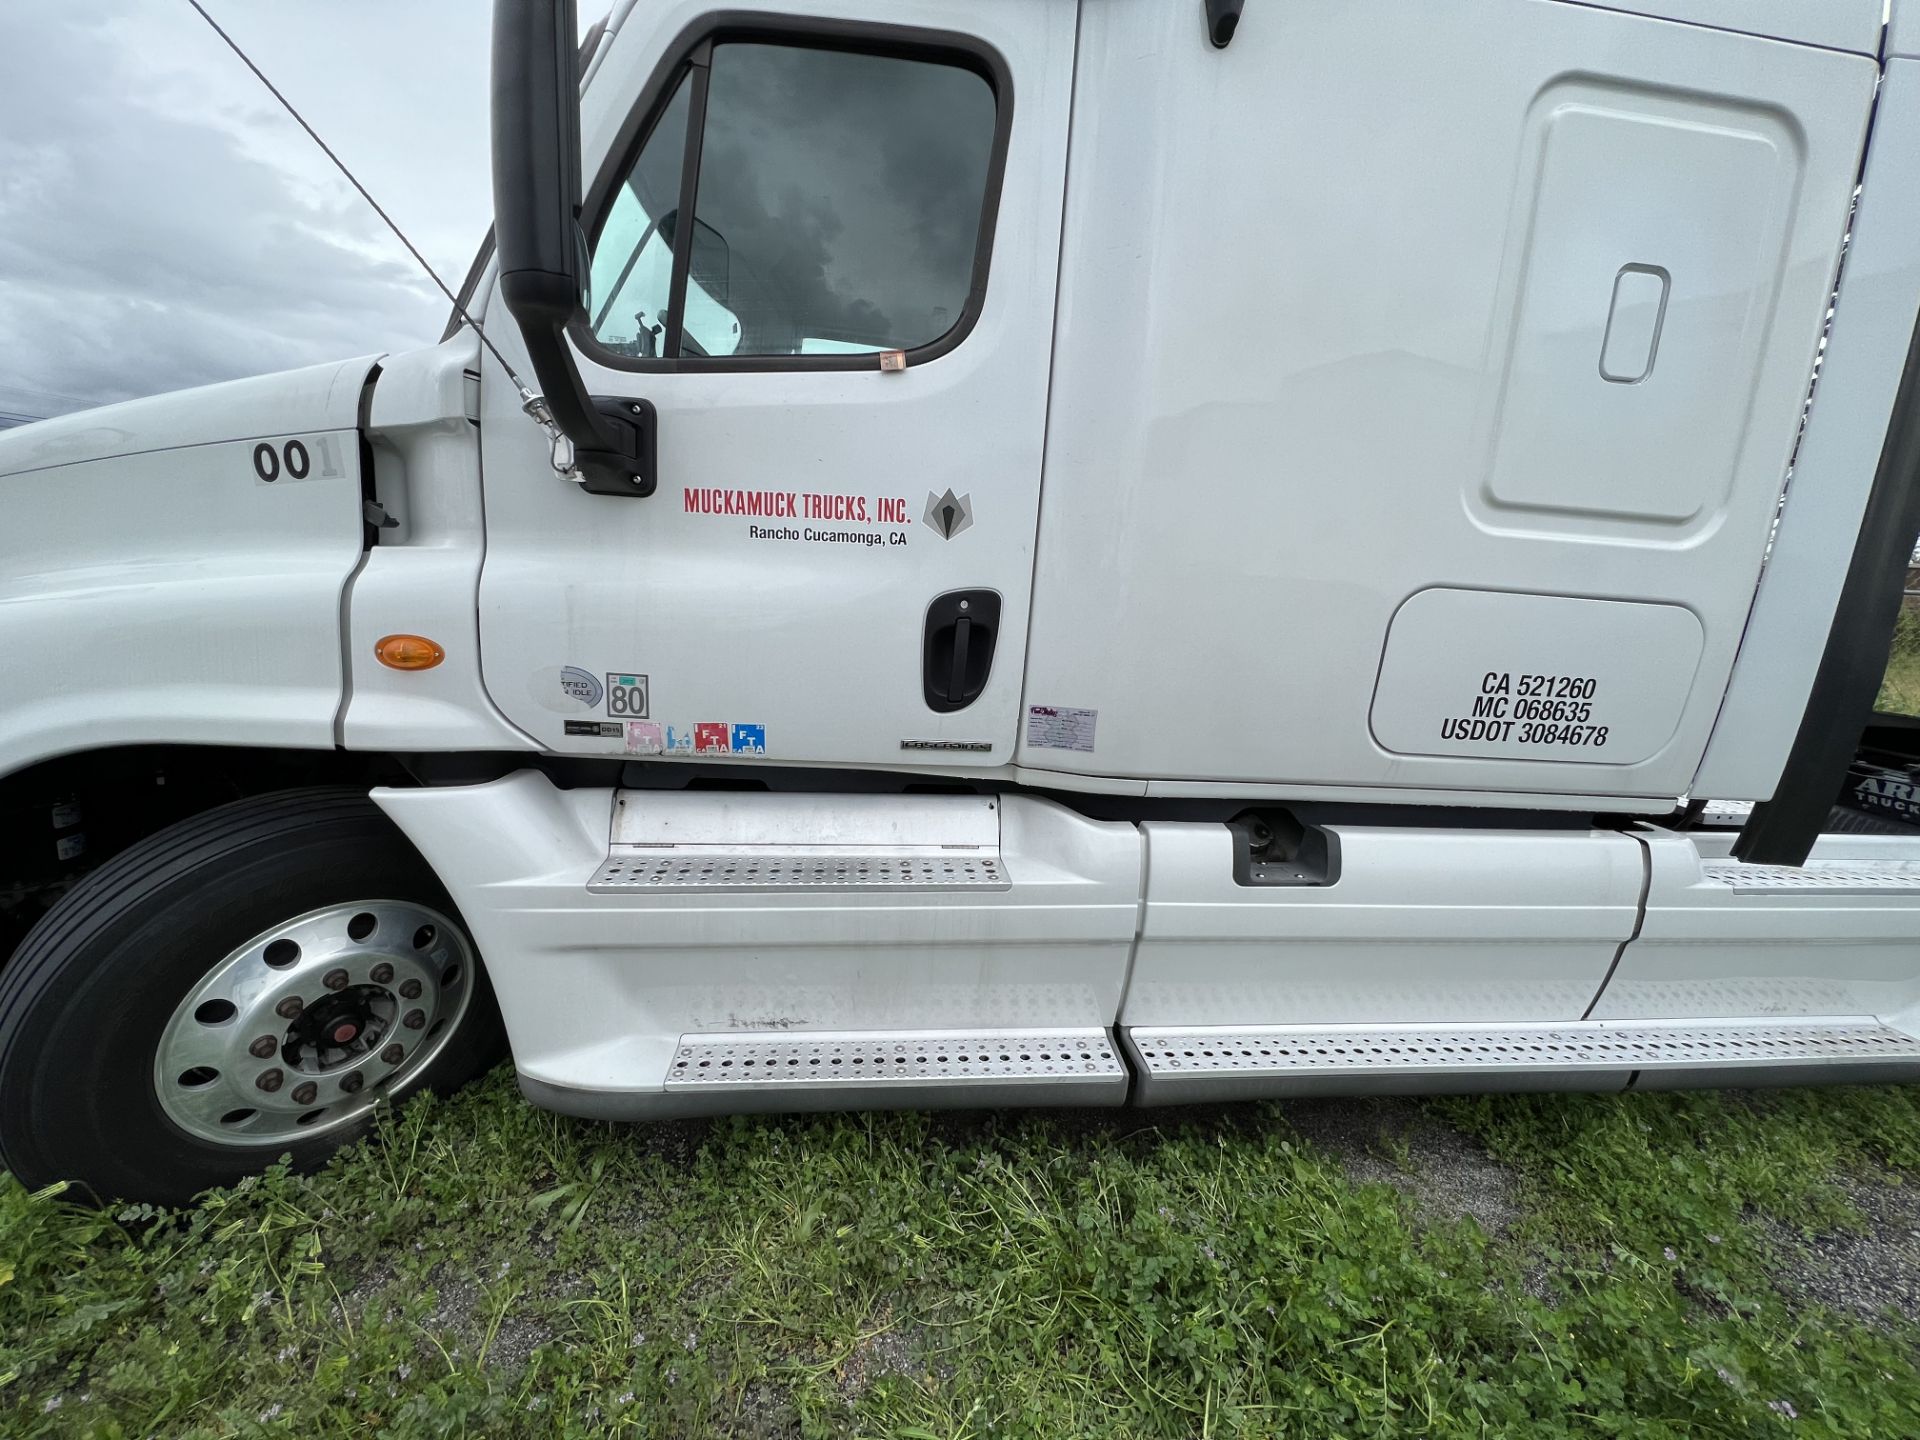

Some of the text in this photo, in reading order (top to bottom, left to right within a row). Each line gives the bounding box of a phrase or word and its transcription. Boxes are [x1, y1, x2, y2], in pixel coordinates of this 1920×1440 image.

[254, 437, 338, 482] 001
[684, 488, 911, 524] MUCKAMUCK TRUCKS, INC.
[750, 525, 907, 546] Rancho Cucamonga, CA
[612, 685, 645, 714] 80
[1482, 672, 1597, 699] CA 521260
[1472, 696, 1592, 722] MC 068635
[1441, 718, 1609, 746] USDOT 3084678
